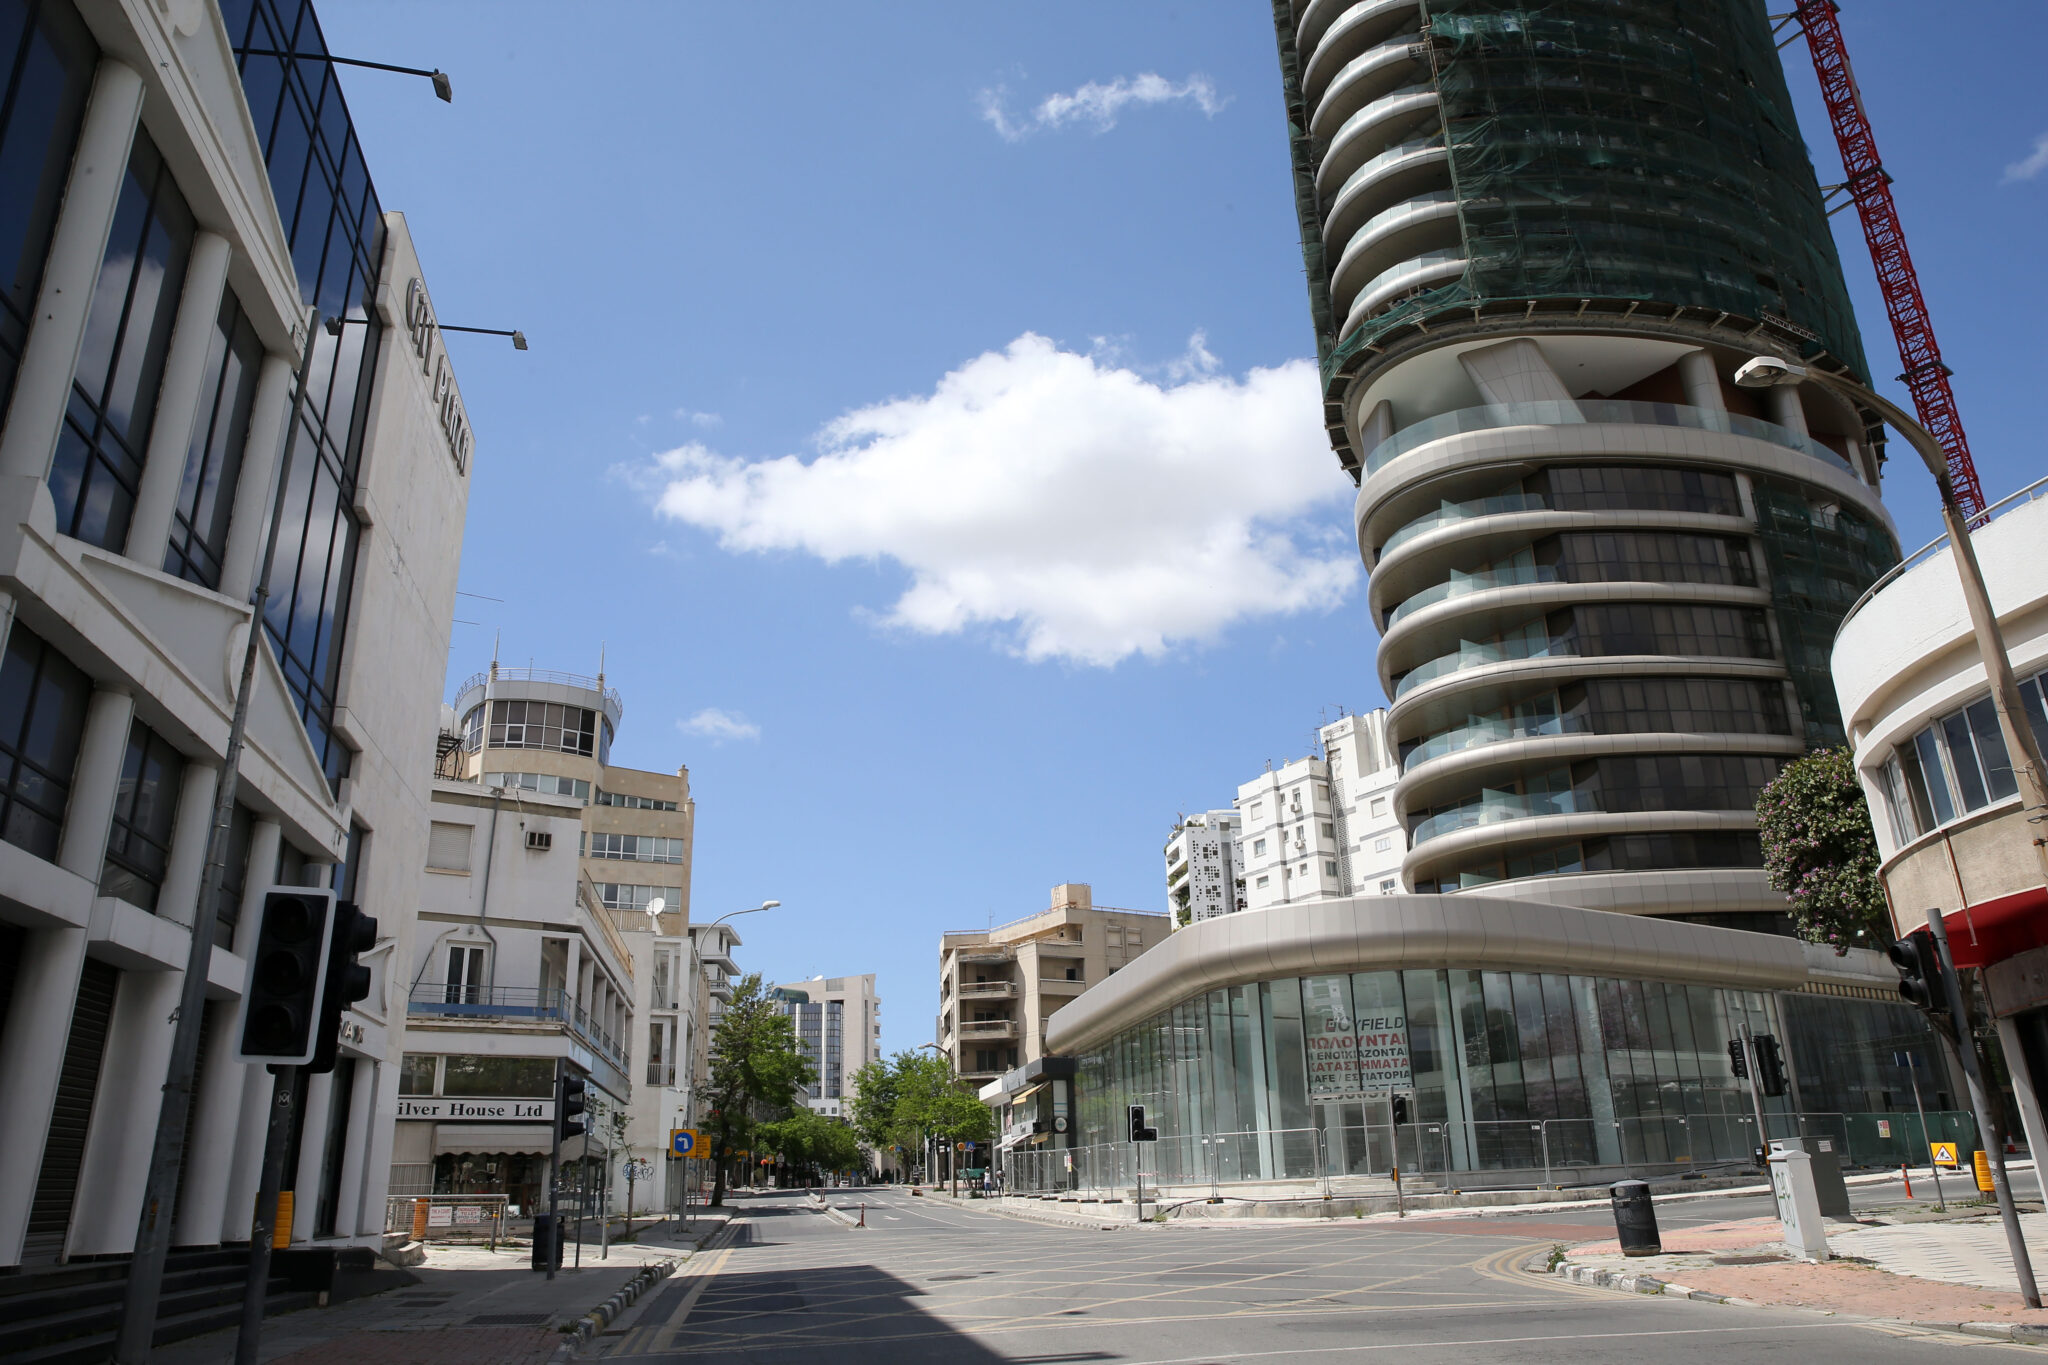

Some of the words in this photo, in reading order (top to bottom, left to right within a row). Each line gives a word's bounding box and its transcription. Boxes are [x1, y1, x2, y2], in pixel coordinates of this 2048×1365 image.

[1311, 1073, 1335, 1083] AFE
[449, 1103, 505, 1117] House
[515, 1104, 543, 1117] Ltd
